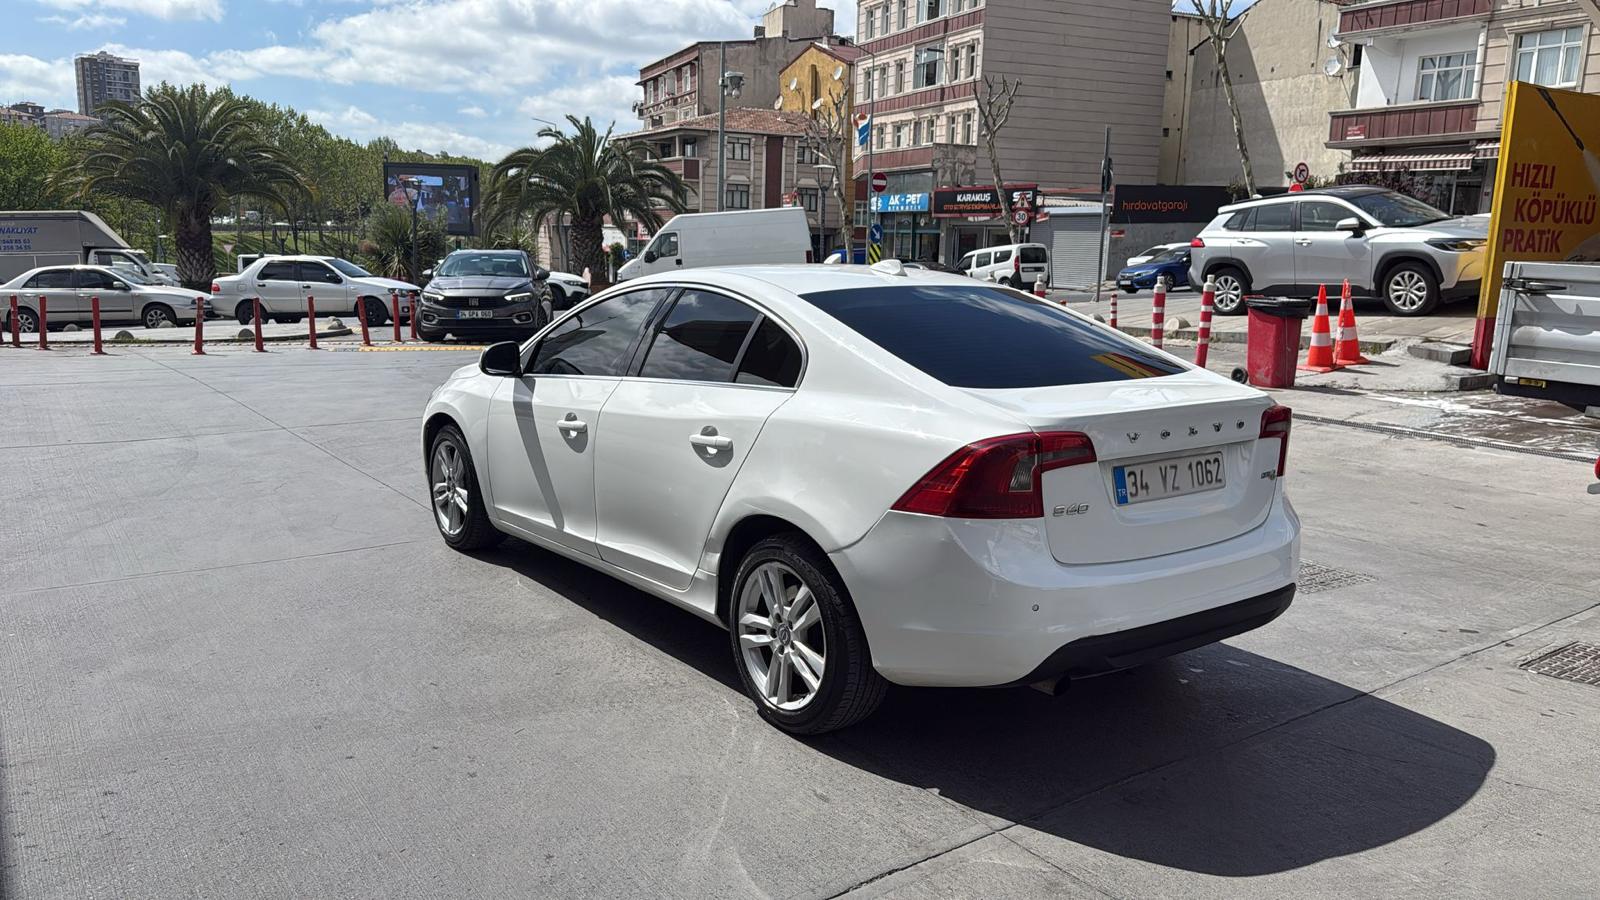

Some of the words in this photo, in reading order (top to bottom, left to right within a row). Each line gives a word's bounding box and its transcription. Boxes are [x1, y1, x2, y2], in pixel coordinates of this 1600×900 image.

[1511, 162, 1556, 189] HIZLI
[889, 195, 900, 205] AK
[906, 193, 921, 205] PET
[956, 193, 991, 202] KARAKUŞ
[1017, 212, 1026, 221] 30
[1514, 191, 1597, 224] KÖPÜKLÜ
[1126, 421, 1245, 443] VOLVO
[1118, 489, 1127, 497] TR
[1127, 471, 1149, 498] 34
[1188, 457, 1223, 488] 1062
[1053, 503, 1089, 517] S60
